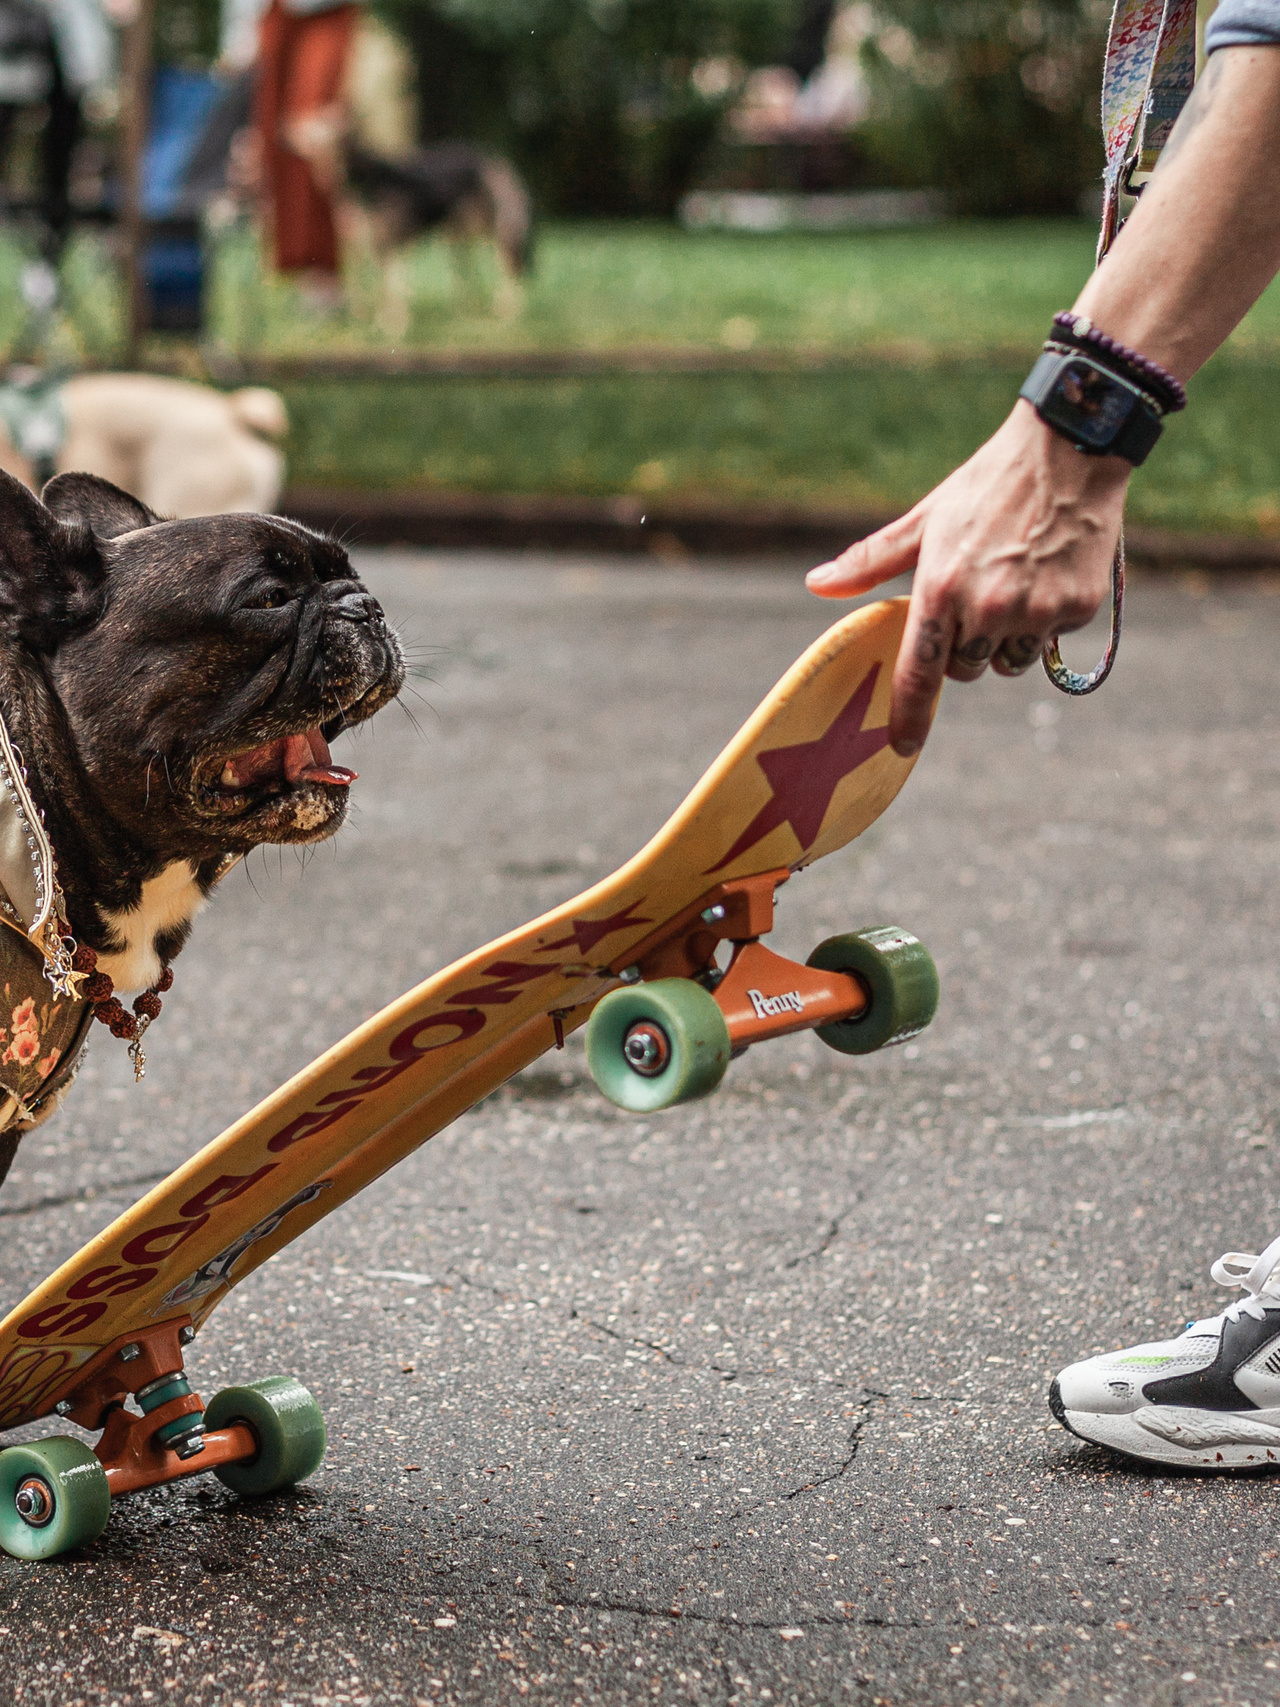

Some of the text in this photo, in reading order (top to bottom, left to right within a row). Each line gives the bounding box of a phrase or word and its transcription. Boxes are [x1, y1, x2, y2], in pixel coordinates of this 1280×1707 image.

[747, 989, 806, 1019] Penny
[17, 960, 561, 1338] NORD BOSS
